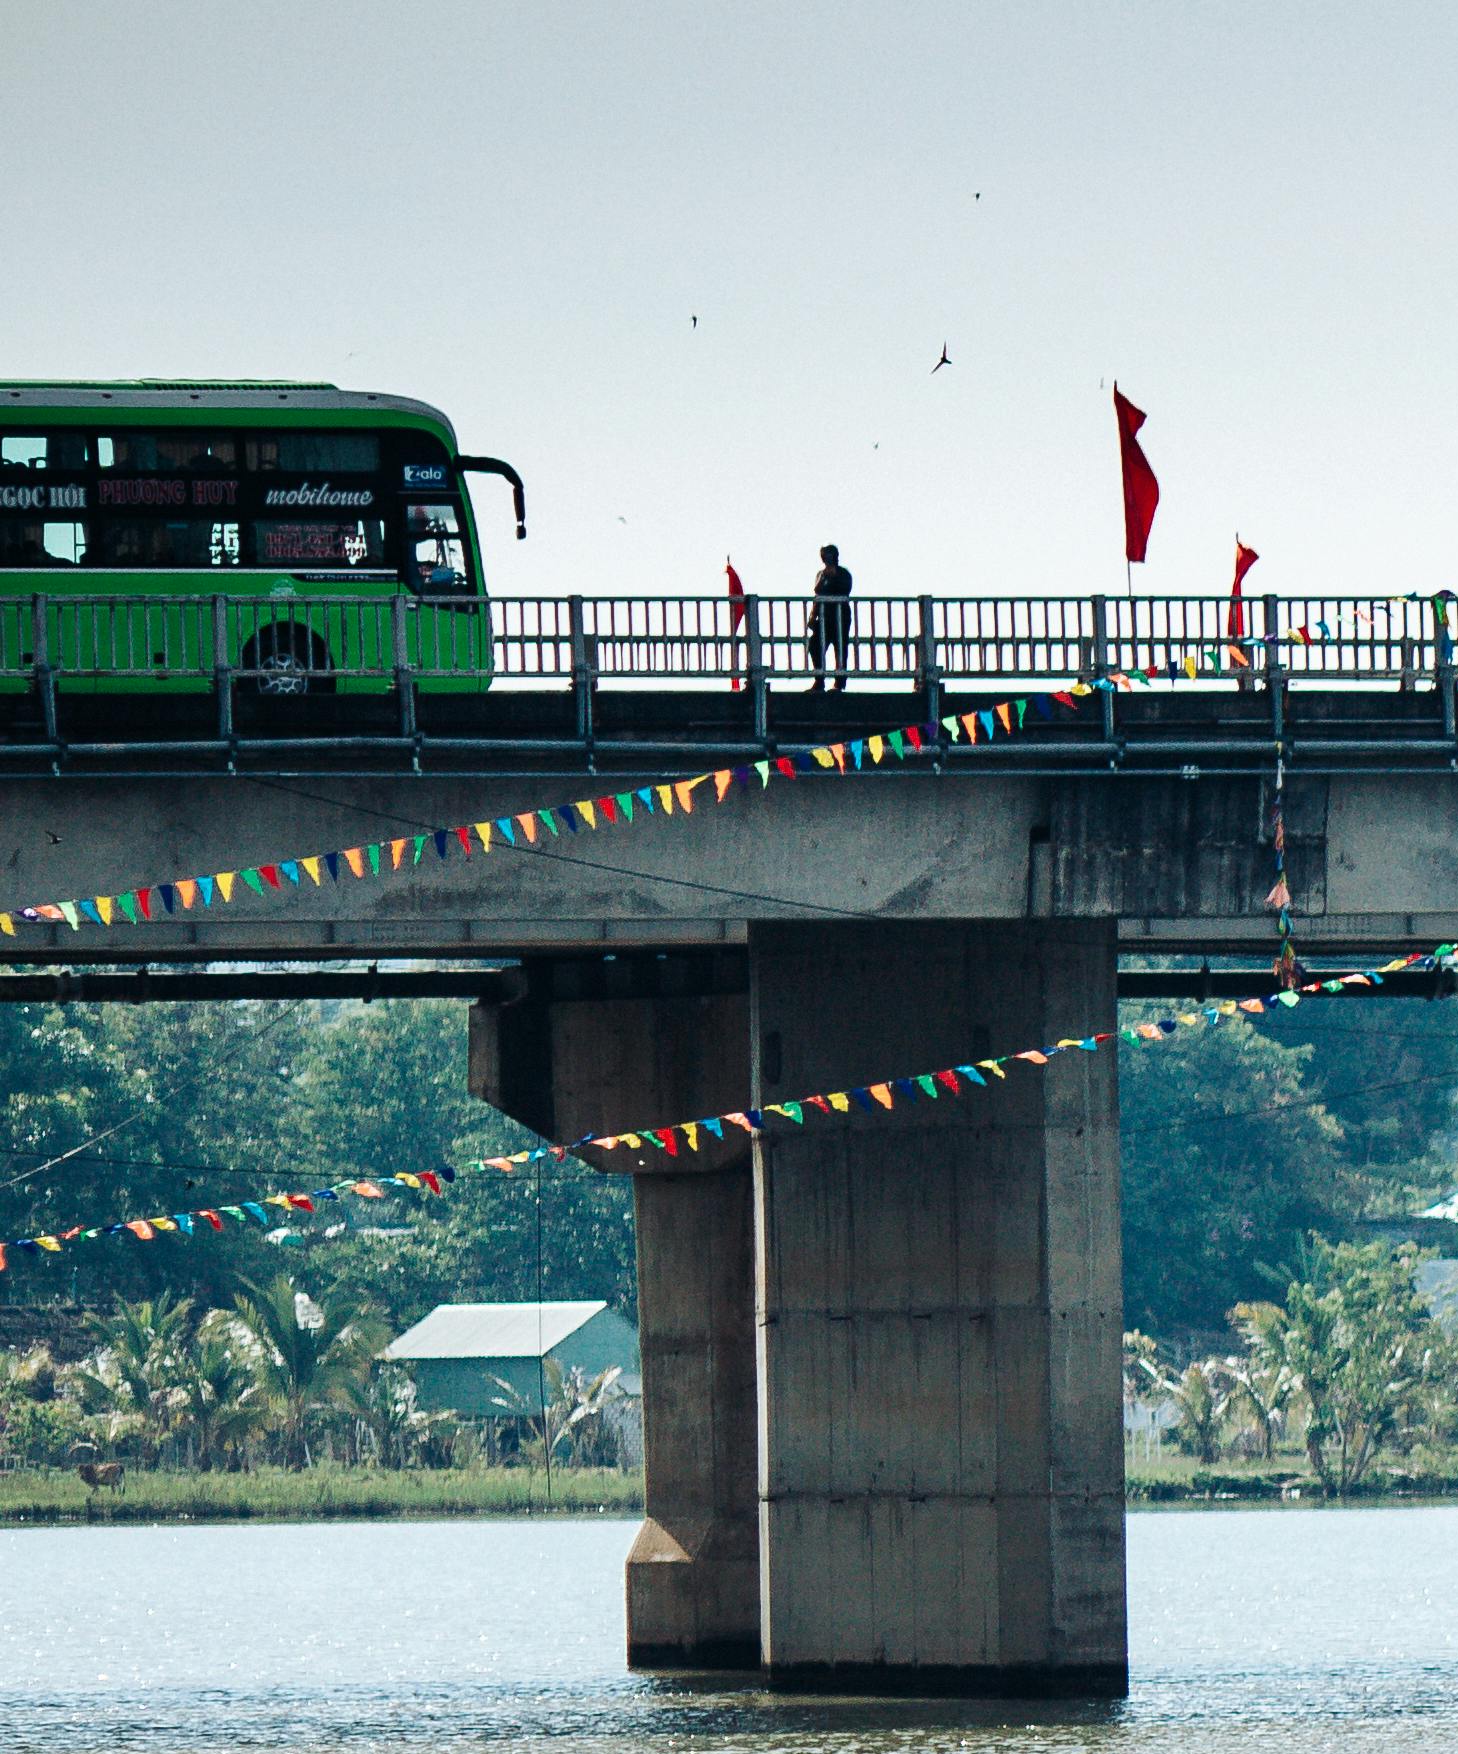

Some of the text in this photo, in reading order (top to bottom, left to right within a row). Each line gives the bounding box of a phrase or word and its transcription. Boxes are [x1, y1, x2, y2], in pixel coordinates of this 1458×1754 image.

[0, 485, 44, 509] GỌC
[191, 480, 240, 505] HUY
[265, 482, 373, 506] mobihome
